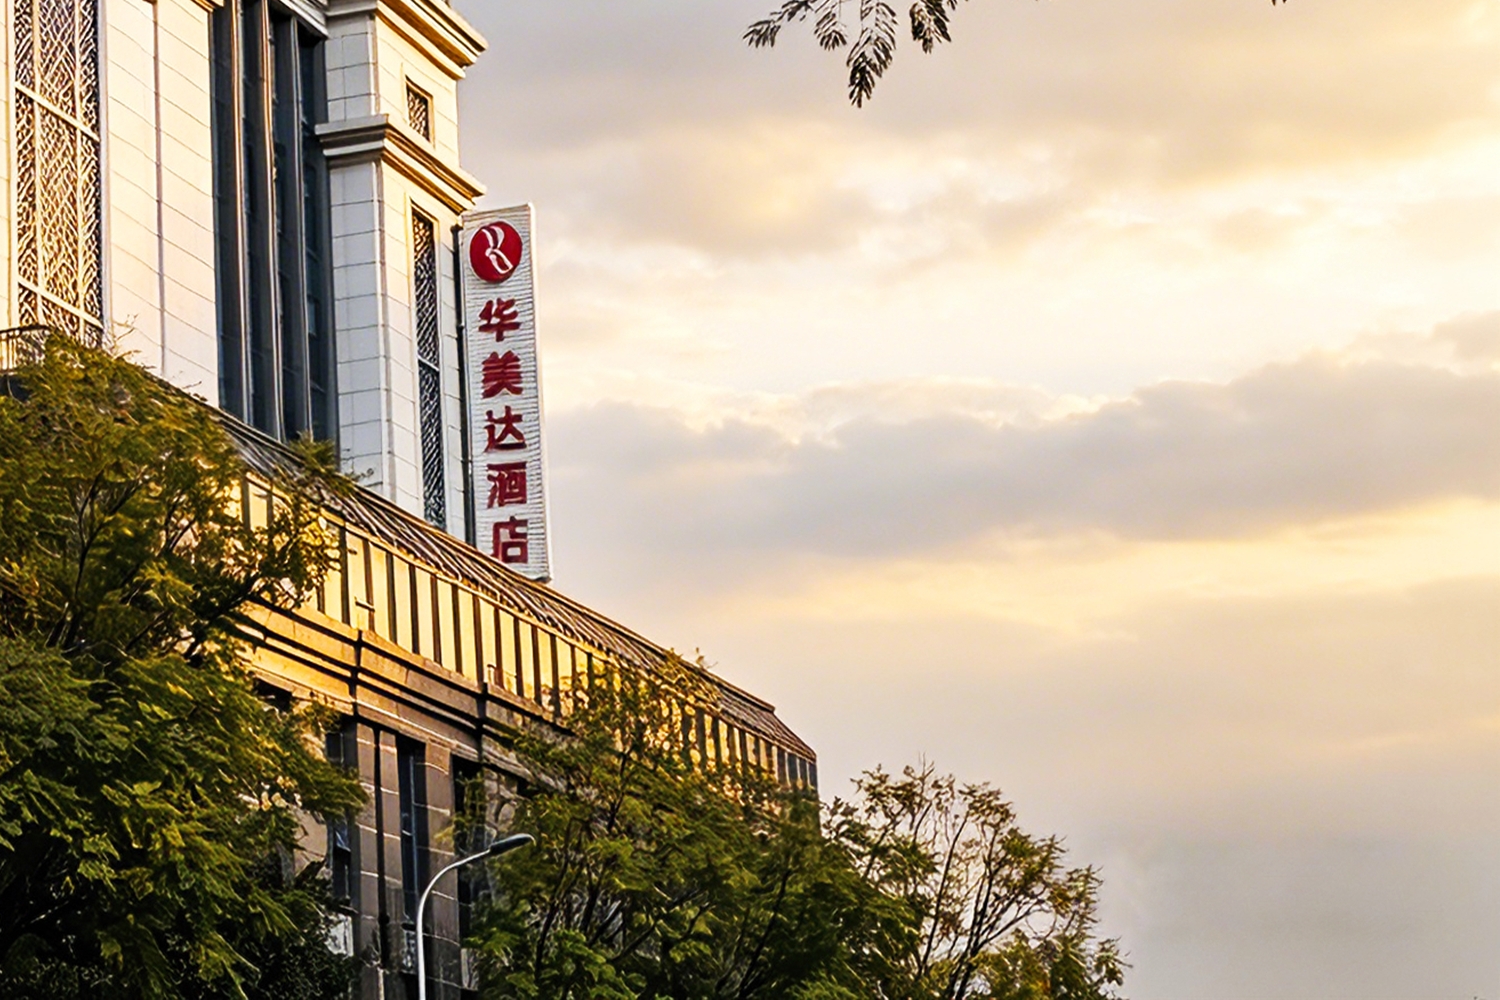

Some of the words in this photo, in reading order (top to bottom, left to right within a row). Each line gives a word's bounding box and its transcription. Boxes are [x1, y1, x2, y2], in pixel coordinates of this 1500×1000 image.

[477, 297, 528, 564] 华美达酒店
